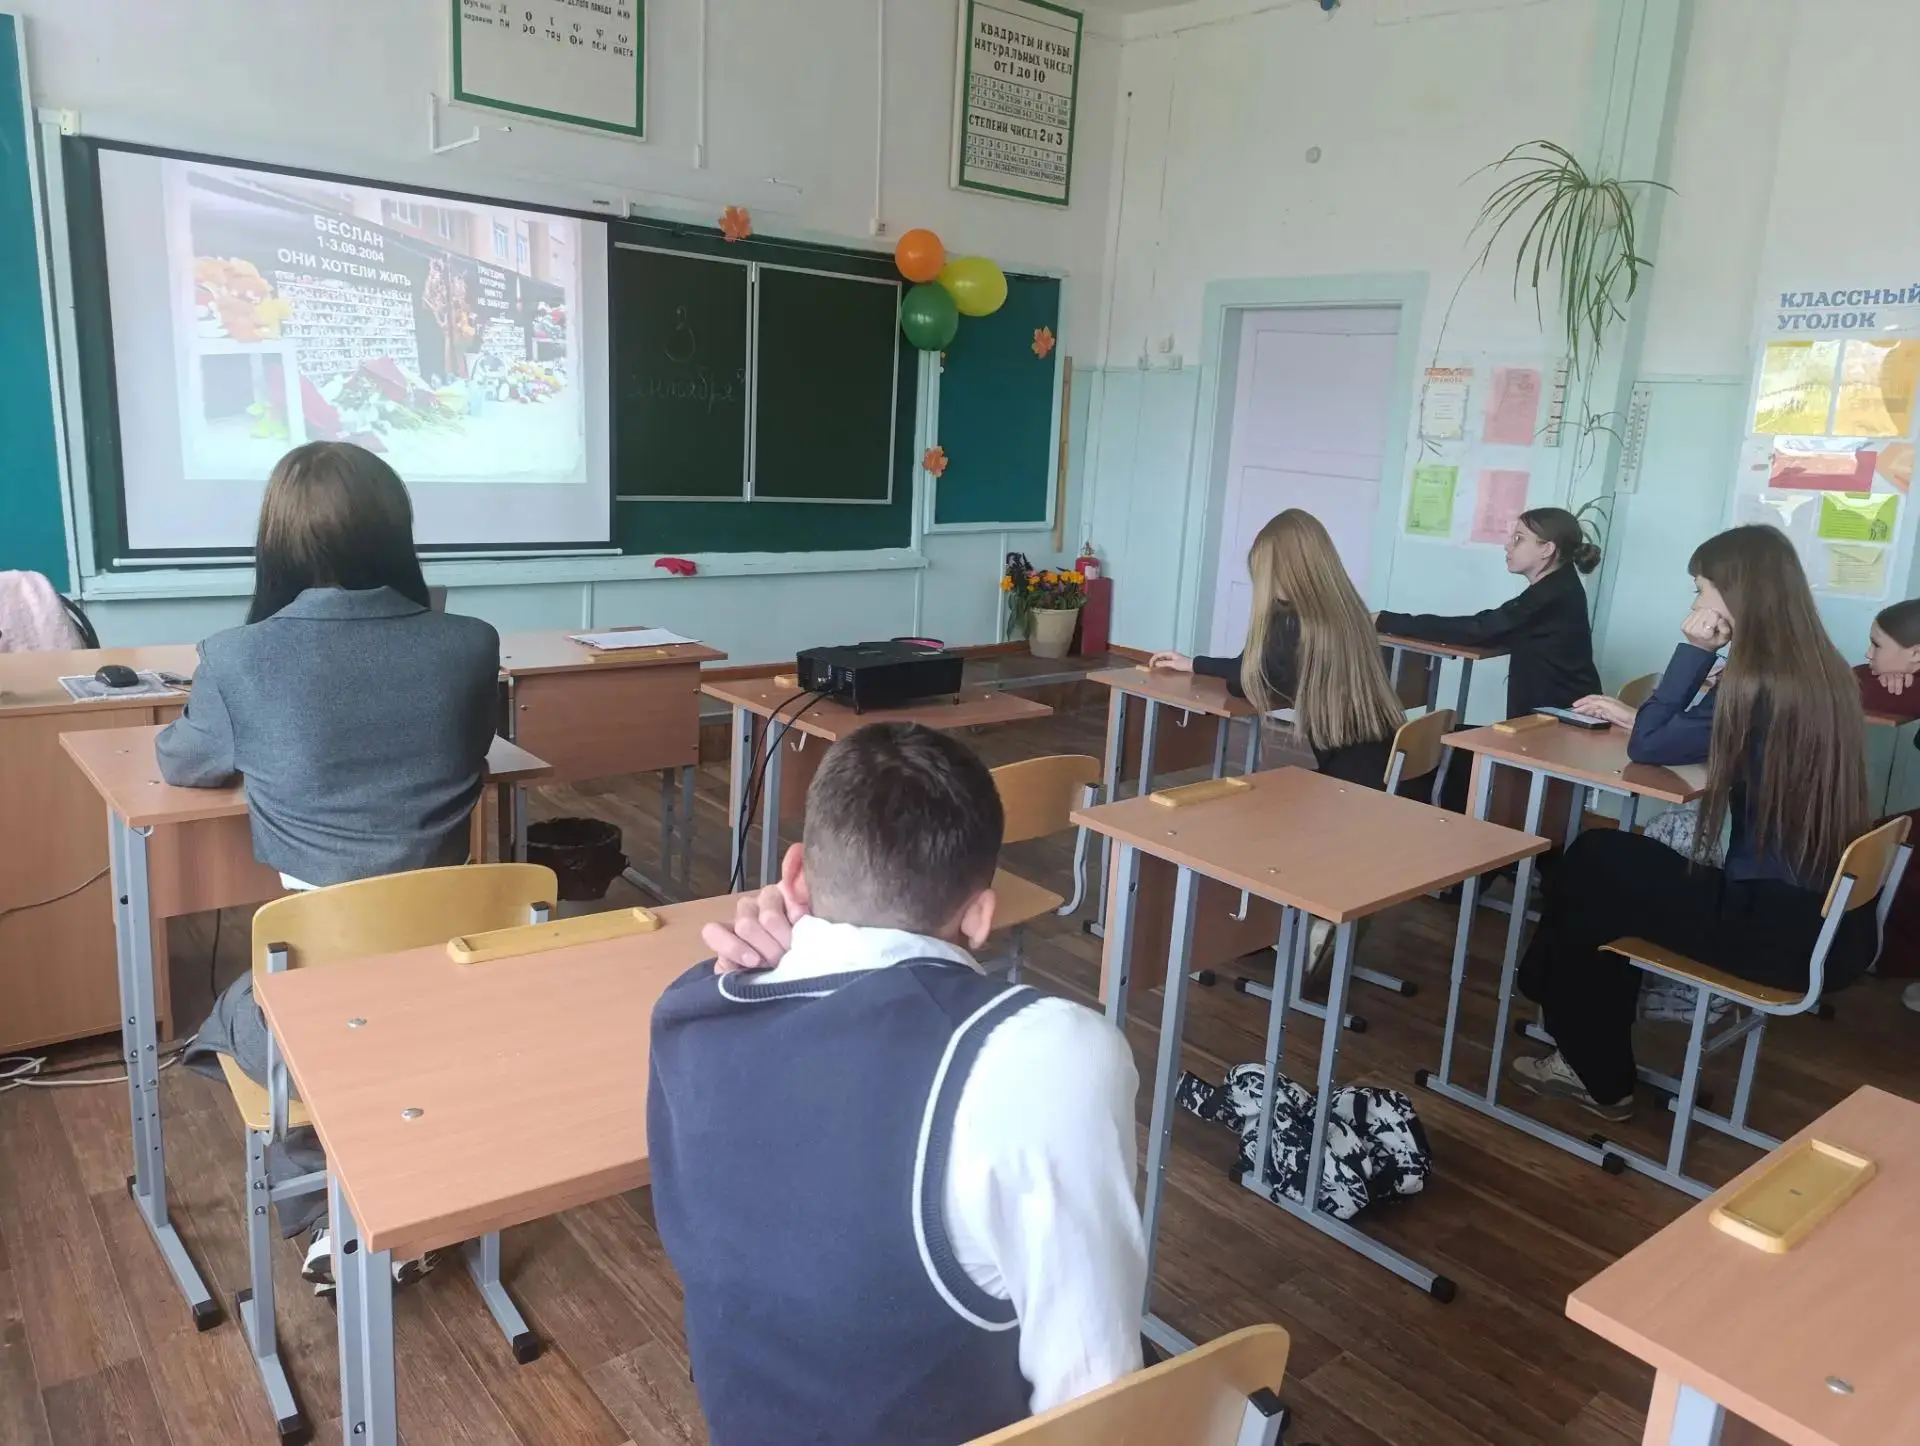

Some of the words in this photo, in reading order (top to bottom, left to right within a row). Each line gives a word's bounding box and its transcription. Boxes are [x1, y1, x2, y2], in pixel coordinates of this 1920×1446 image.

[974, 37, 1041, 66] НАТУРАЛЬНЫХ
[1043, 56, 1073, 75] ЧИСЕЛ
[980, 22, 1034, 48] КВАДРАТЫ
[1036, 38, 1044, 50] И
[1045, 41, 1070, 58] КУБЫ
[1034, 68, 1046, 83] 10
[968, 113, 1008, 133] СТЕПЕНИ
[1010, 123, 1038, 140] ЧИСЕЛ
[1040, 128, 1046, 142] 2
[1055, 132, 1063, 146] 3
[314, 214, 384, 248] БЕСЛАН
[318, 236, 384, 262] 1-3.09.2004
[277, 248, 316, 268] ОНИ
[320, 256, 377, 280] ХОТЕЛИ
[379, 270, 412, 286] ЖИТЬ
[1780, 282, 1920, 308] КЛАССНЫЙ
[1777, 312, 1877, 330] УГОЛОК
